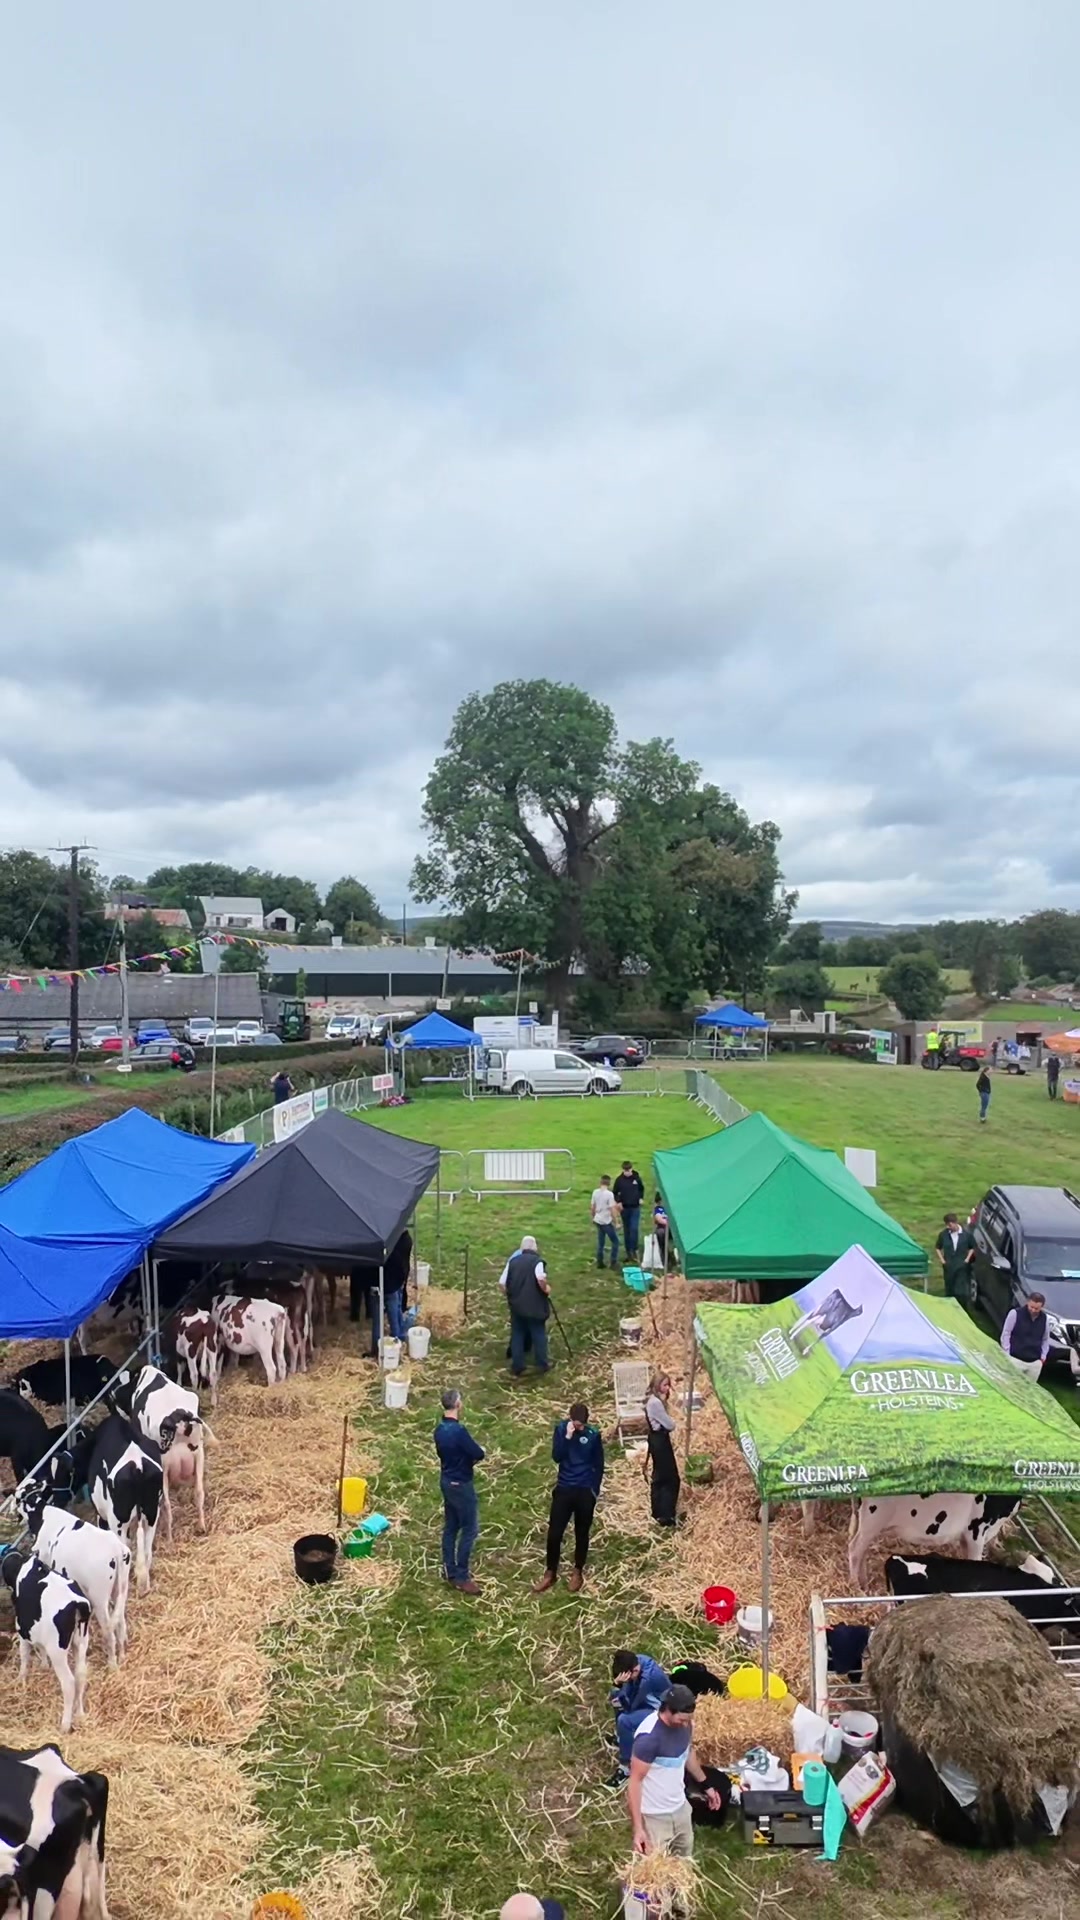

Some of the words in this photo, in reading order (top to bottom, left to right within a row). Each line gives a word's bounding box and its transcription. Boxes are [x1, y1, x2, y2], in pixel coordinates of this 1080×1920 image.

[850, 1369, 977, 1394] GREENLEA
[877, 1395, 958, 1412] HOLSTEINS
[1014, 1459, 1080, 1478] GREENL
